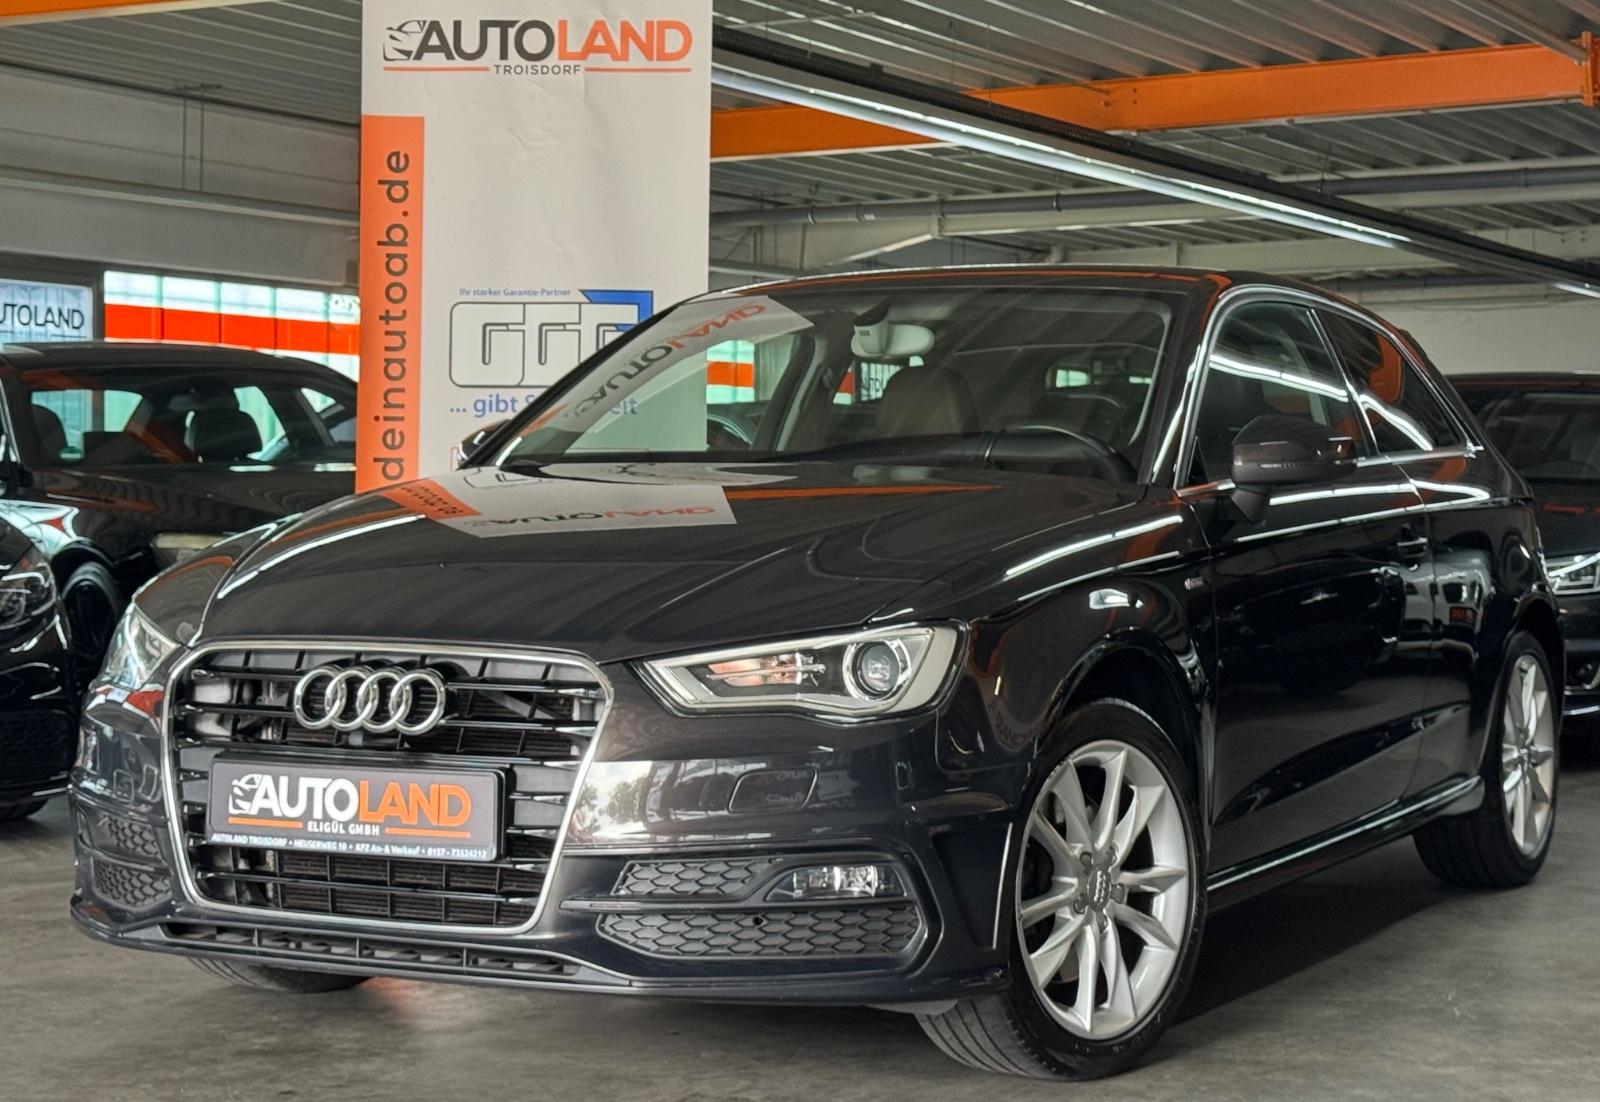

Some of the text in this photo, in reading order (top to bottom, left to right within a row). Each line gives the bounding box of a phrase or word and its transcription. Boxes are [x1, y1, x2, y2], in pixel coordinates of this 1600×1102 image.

[412, 19, 693, 62] AUTOLAND
[494, 64, 581, 76] TROISDORF
[459, 288, 471, 296] Ihr
[473, 288, 501, 297] starker
[373, 150, 410, 481] deinautoab.de
[473, 394, 517, 418] gibt
[250, 774, 472, 827] AUTOLAND
[211, 833, 248, 844] AUTOLAND
[307, 820, 380, 837] ELIGÜL GMBH
